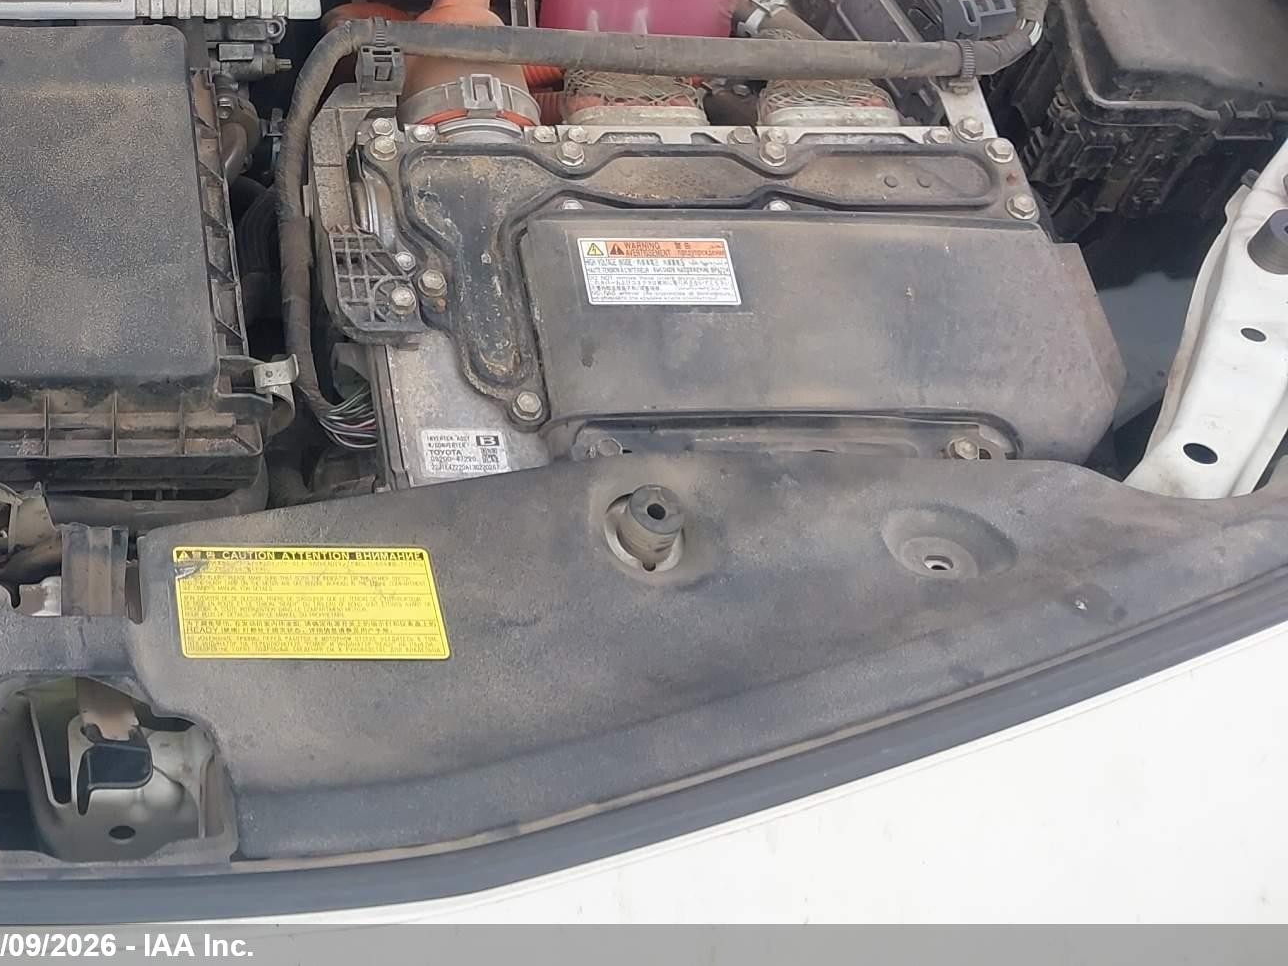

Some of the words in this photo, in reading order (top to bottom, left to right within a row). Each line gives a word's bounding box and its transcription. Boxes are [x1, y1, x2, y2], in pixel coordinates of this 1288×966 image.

[623, 241, 661, 250] WARNING
[479, 436, 496, 446] B
[222, 551, 274, 560] CAUTION
[281, 551, 350, 560] ATTENTION
[355, 551, 424, 561] ВНИМАНИЕ
